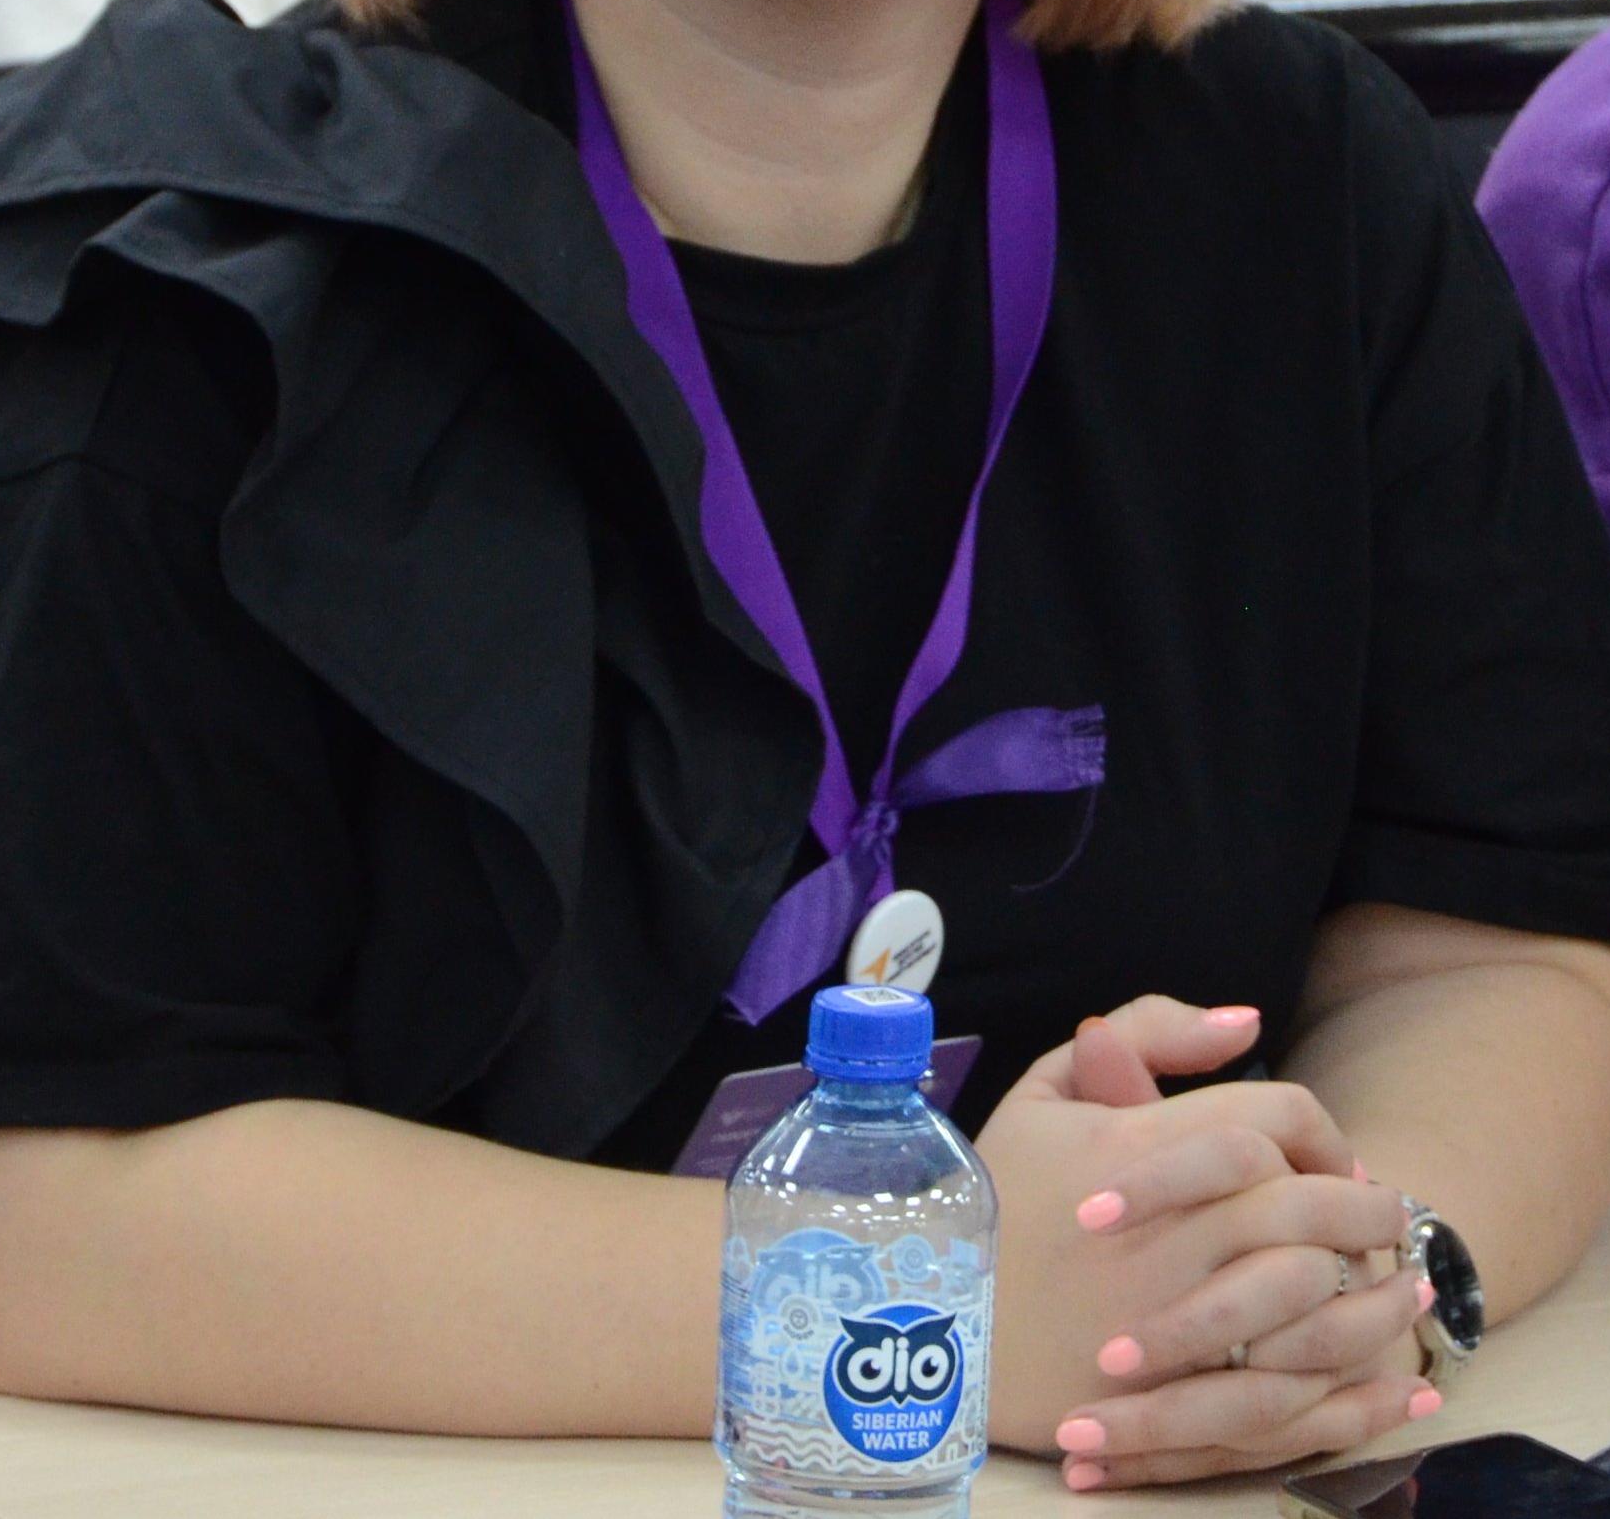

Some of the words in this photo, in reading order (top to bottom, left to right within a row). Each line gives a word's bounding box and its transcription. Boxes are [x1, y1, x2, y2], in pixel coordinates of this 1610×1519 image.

[847, 1336, 950, 1393] dio
[852, 1408, 943, 1430] SIBERIAN
[861, 1430, 931, 1451] WATER
